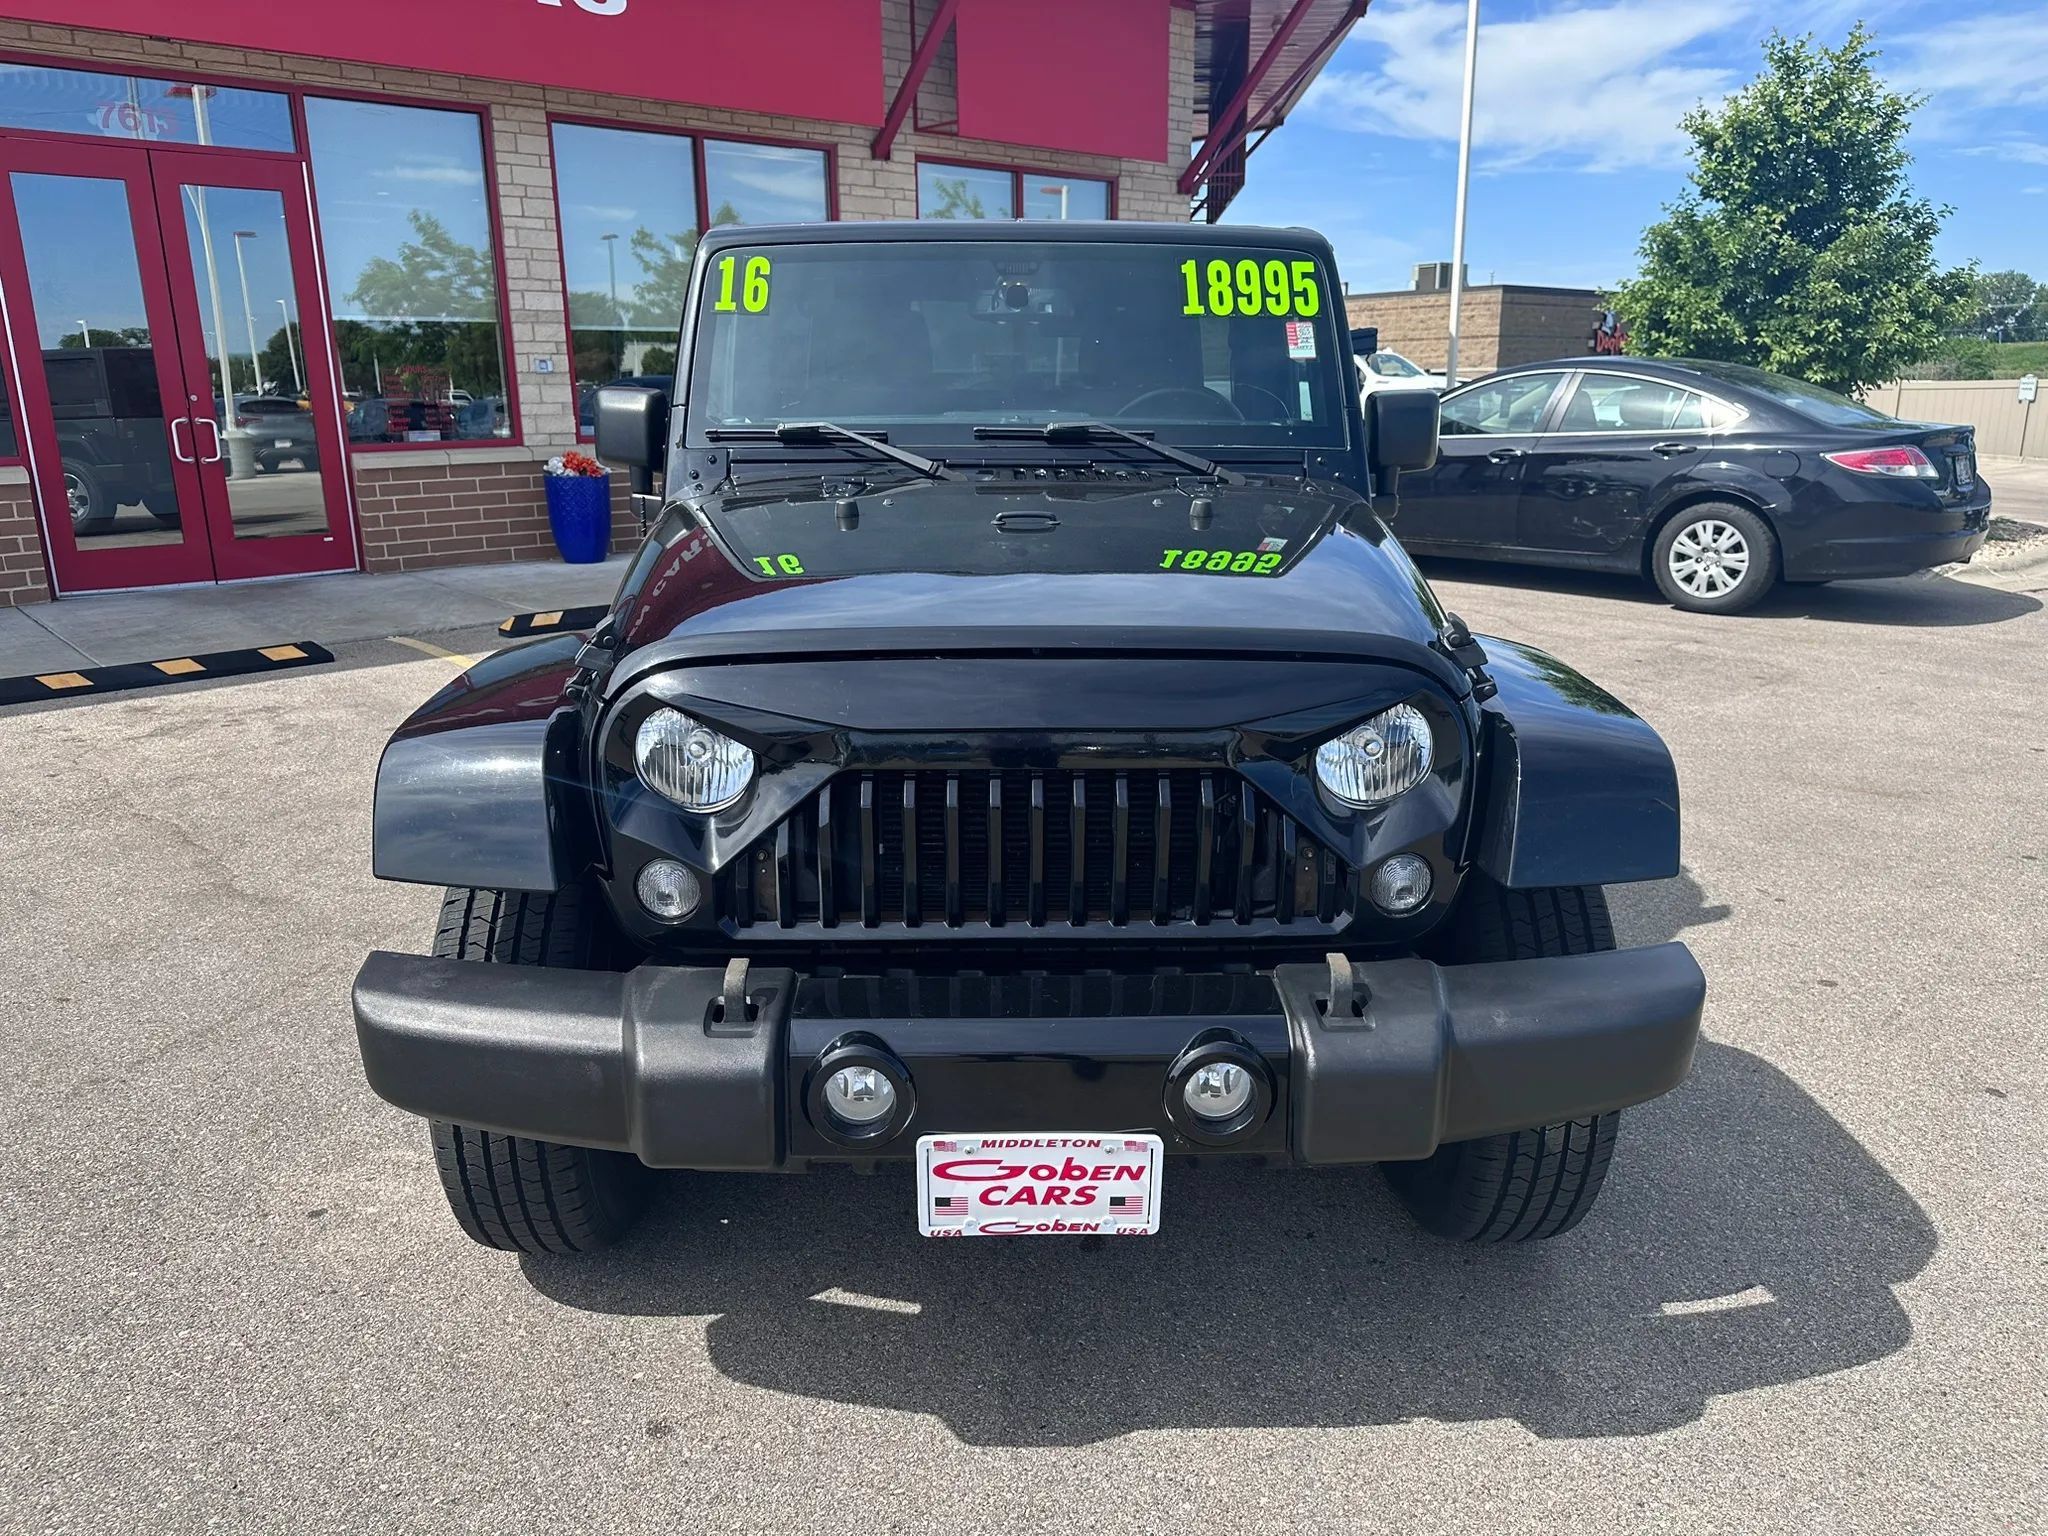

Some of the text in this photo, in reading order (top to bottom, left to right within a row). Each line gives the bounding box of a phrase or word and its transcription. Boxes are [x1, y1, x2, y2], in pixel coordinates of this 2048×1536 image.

[715, 256, 771, 312] 16
[1181, 259, 1320, 317] 18995
[980, 1139, 1102, 1149] MIDDLETON
[978, 1185, 1100, 1207] CARS
[930, 1229, 963, 1238] USA
[1115, 1227, 1149, 1236] USA
